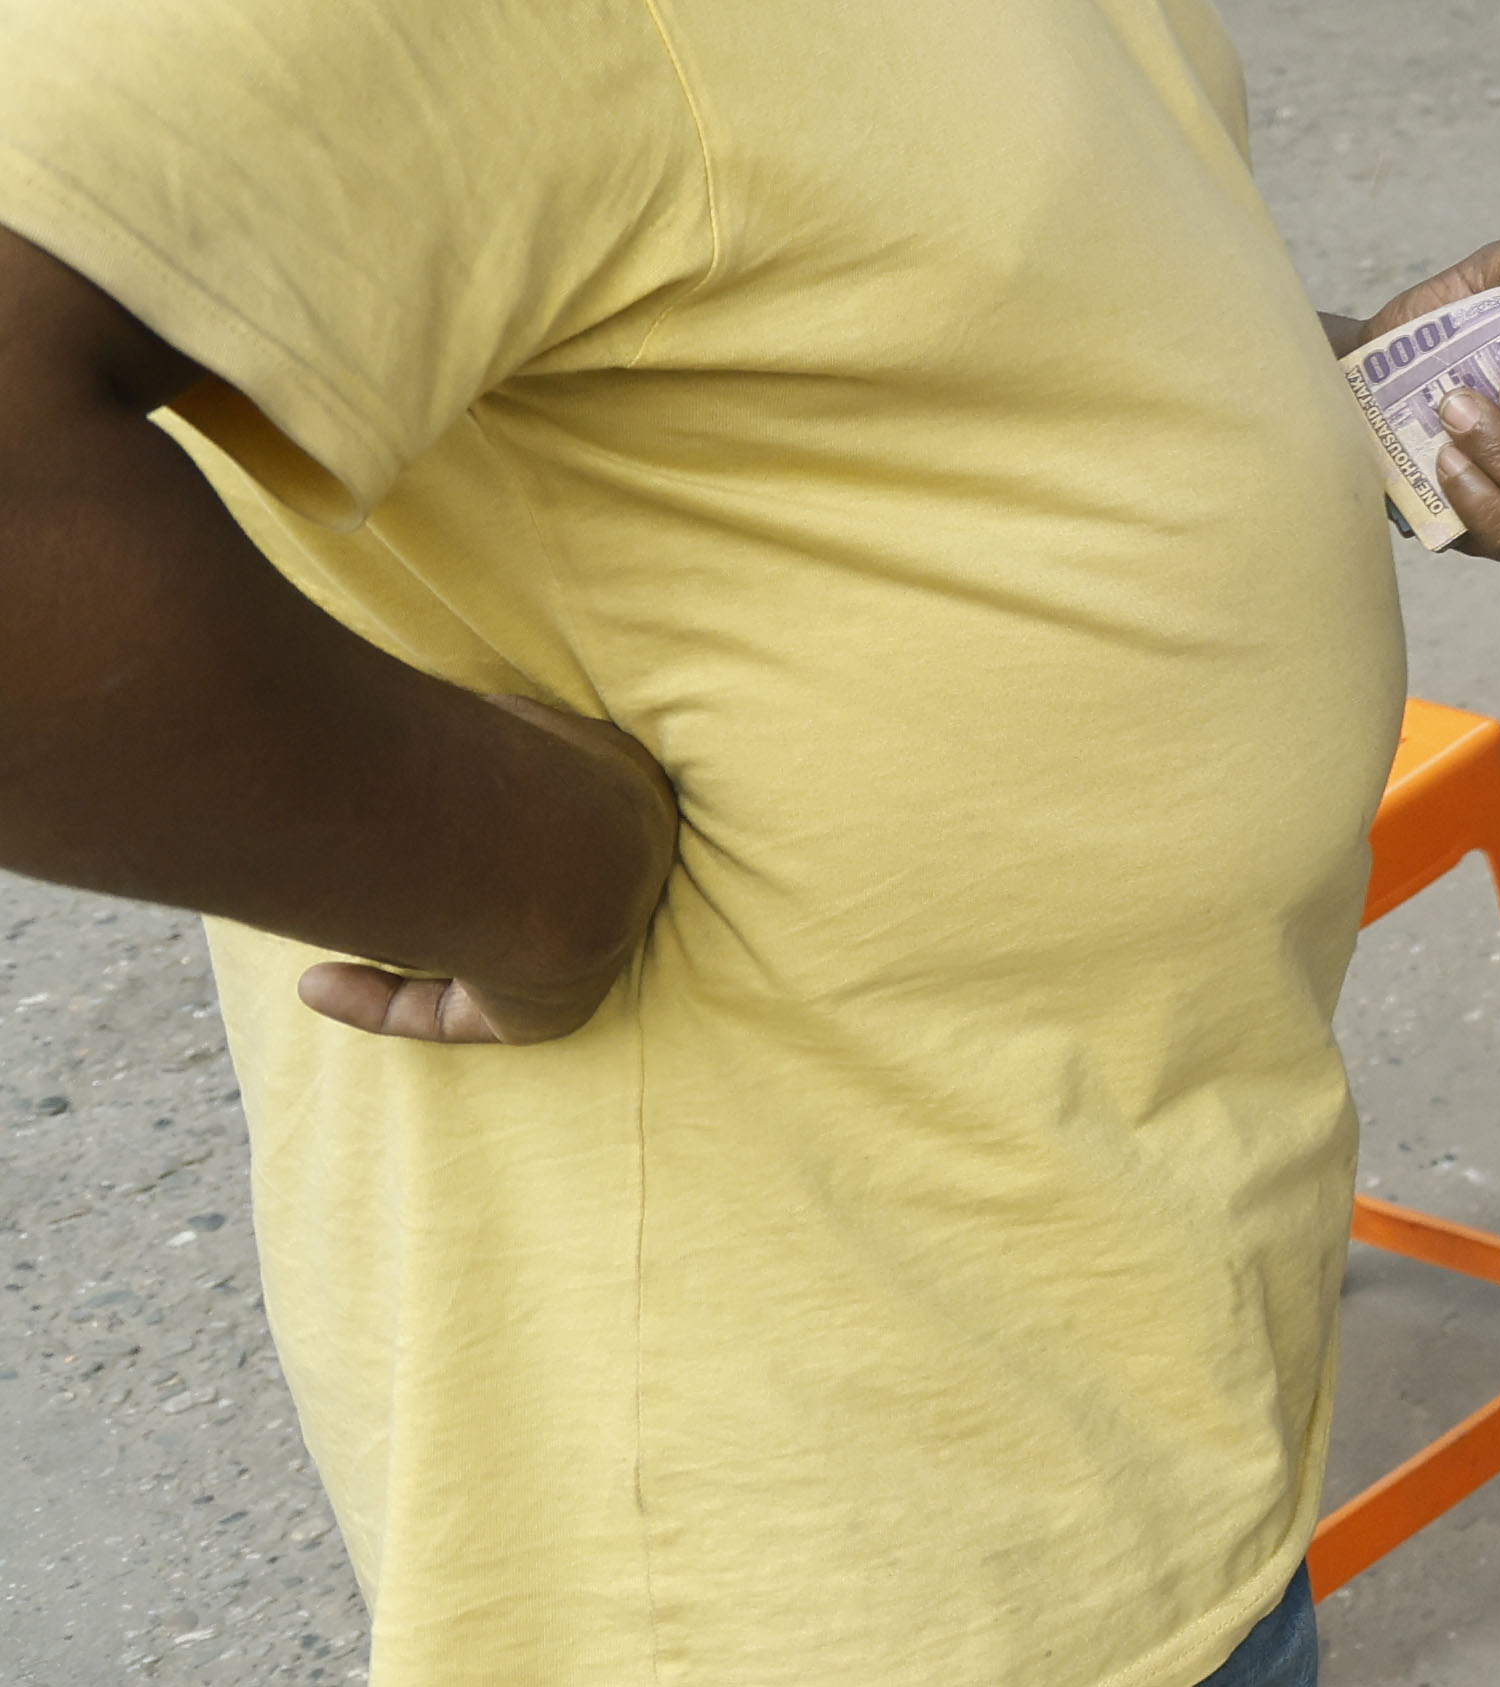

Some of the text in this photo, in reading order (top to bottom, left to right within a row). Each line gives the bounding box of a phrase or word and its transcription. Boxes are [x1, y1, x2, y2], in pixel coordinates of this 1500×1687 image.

[1362, 315, 1459, 384] 1000
[1366, 406, 1425, 486] THOUSAND
[1416, 480, 1445, 516] ONE
